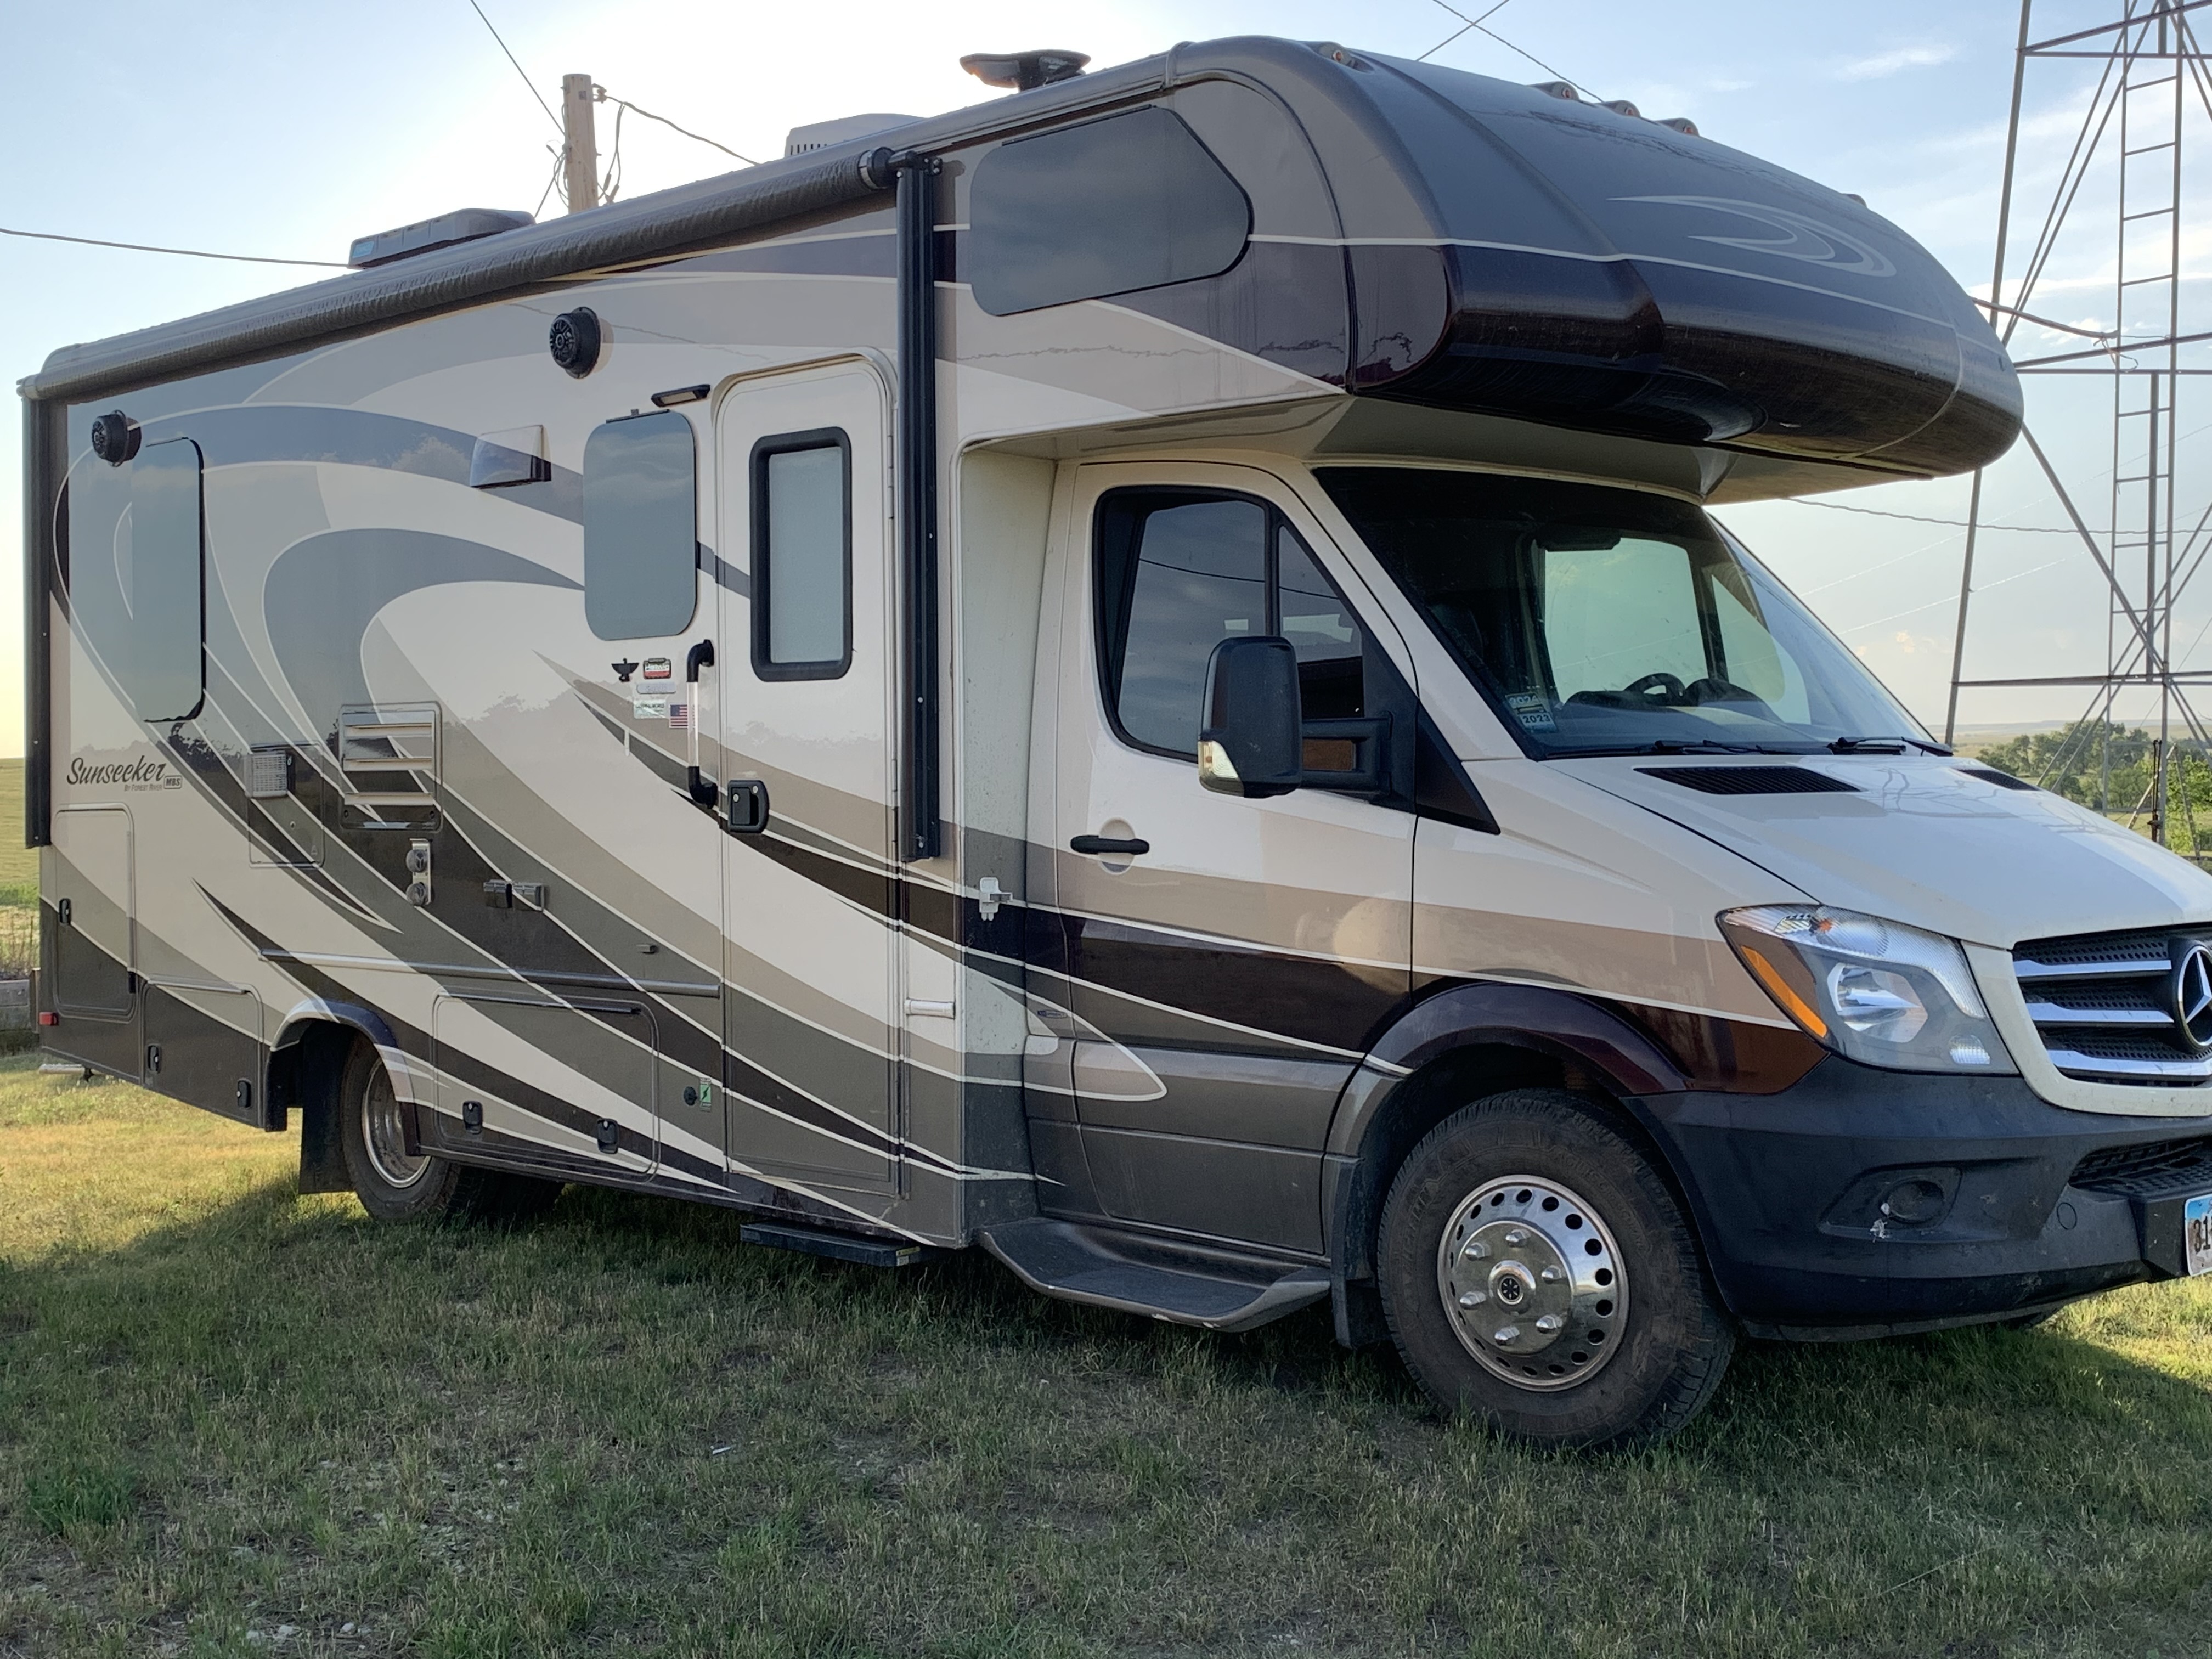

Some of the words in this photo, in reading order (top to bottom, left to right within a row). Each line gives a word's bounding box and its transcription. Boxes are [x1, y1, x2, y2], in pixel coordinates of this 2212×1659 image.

[1522, 714, 1550, 723] 2023
[66, 755, 167, 785] Sunseeker
[166, 778, 180, 786] MBS
